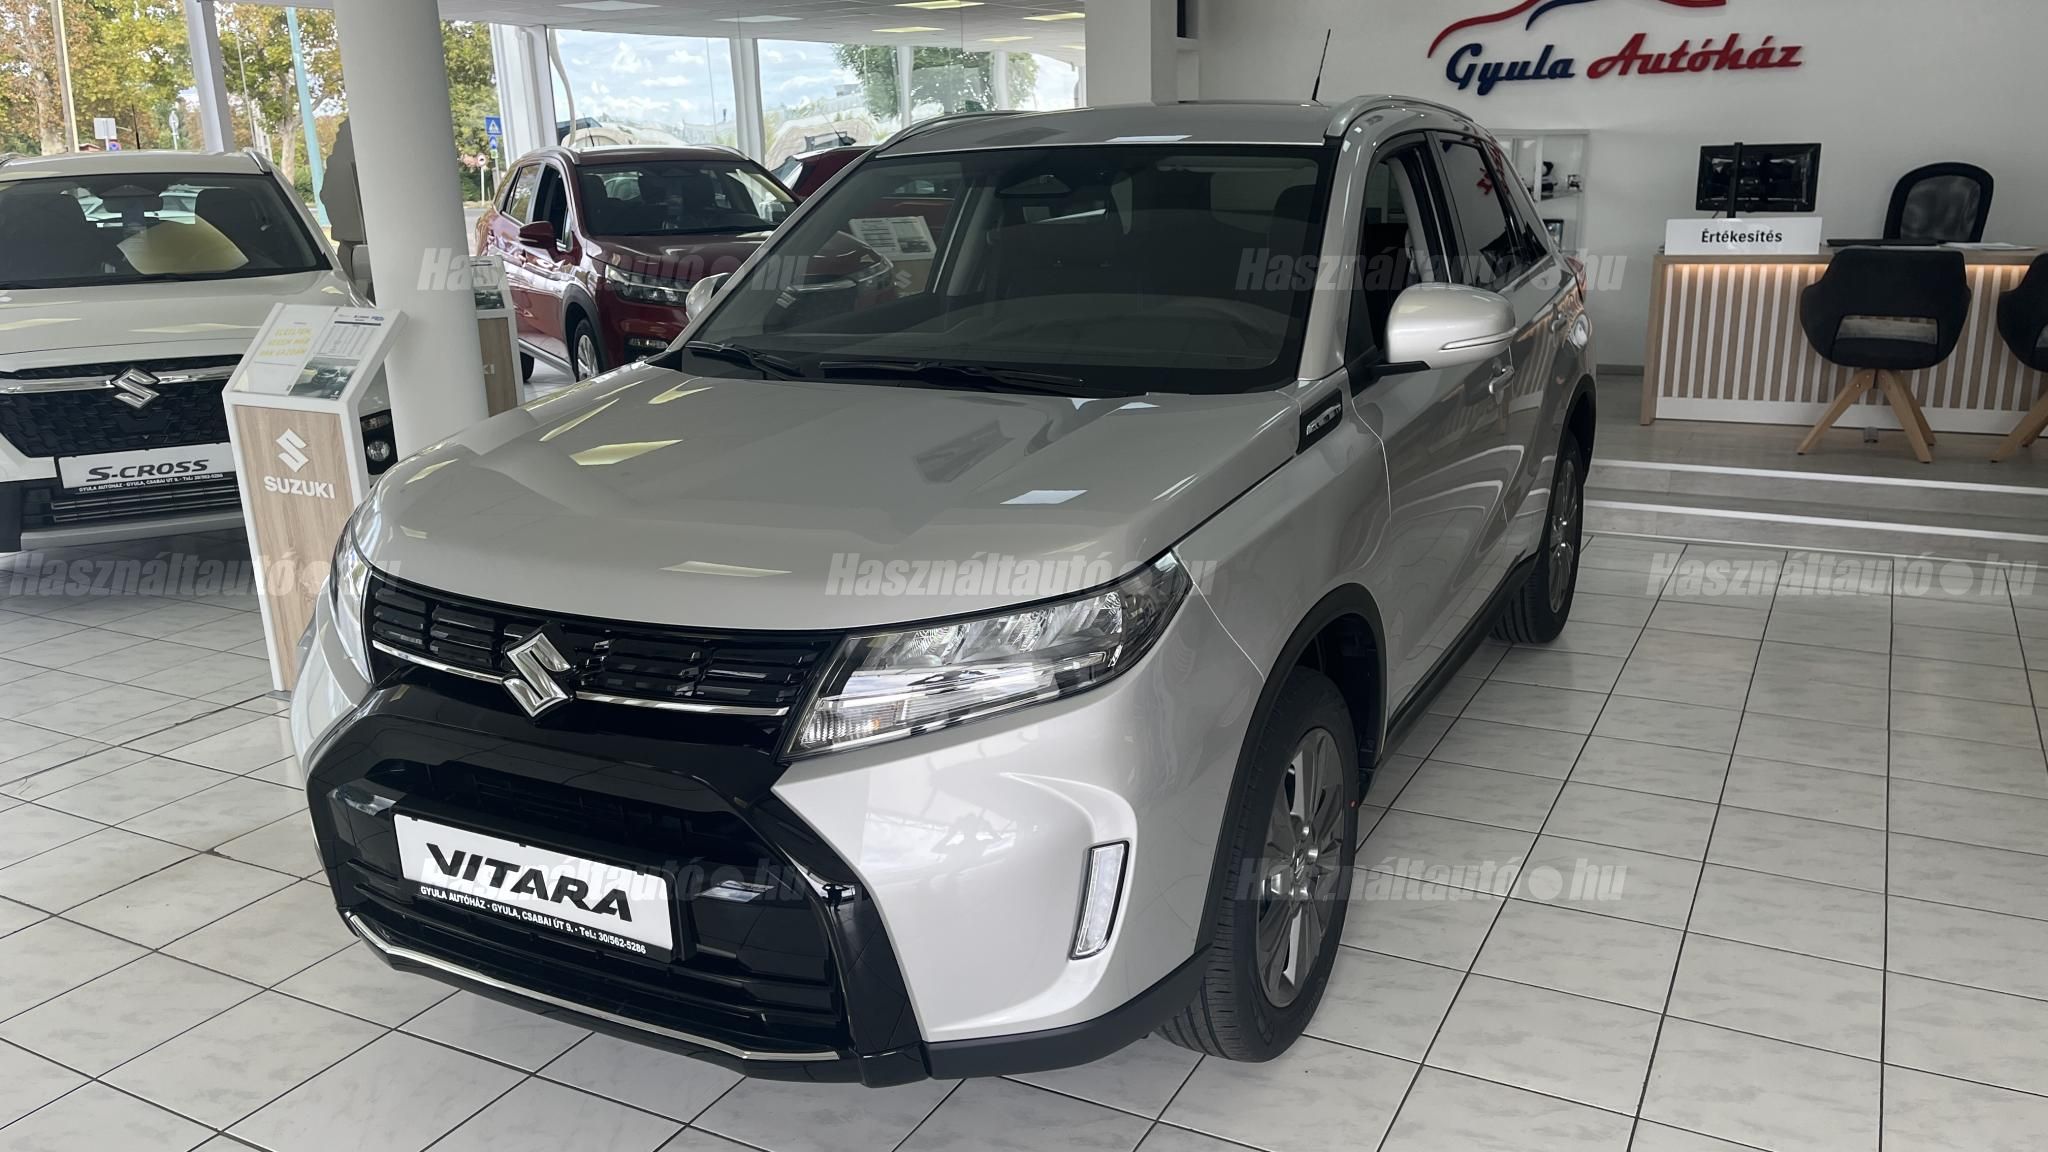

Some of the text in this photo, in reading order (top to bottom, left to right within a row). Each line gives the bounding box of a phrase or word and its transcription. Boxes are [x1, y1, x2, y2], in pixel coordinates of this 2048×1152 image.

[1445, 33, 1803, 96] Gyula Autóház
[1701, 228, 1783, 243] Értékesítés
[86, 459, 209, 482] S-CROSS
[264, 475, 336, 499] SUZUKI
[426, 842, 632, 922] VITARA
[420, 886, 447, 899] GYULA
[448, 893, 486, 909] AUTÓHÁZ
[491, 903, 521, 920] GYULA,
[521, 911, 552, 927] CSABAI
[554, 918, 565, 930] ÚT
[565, 923, 574, 933] 9.
